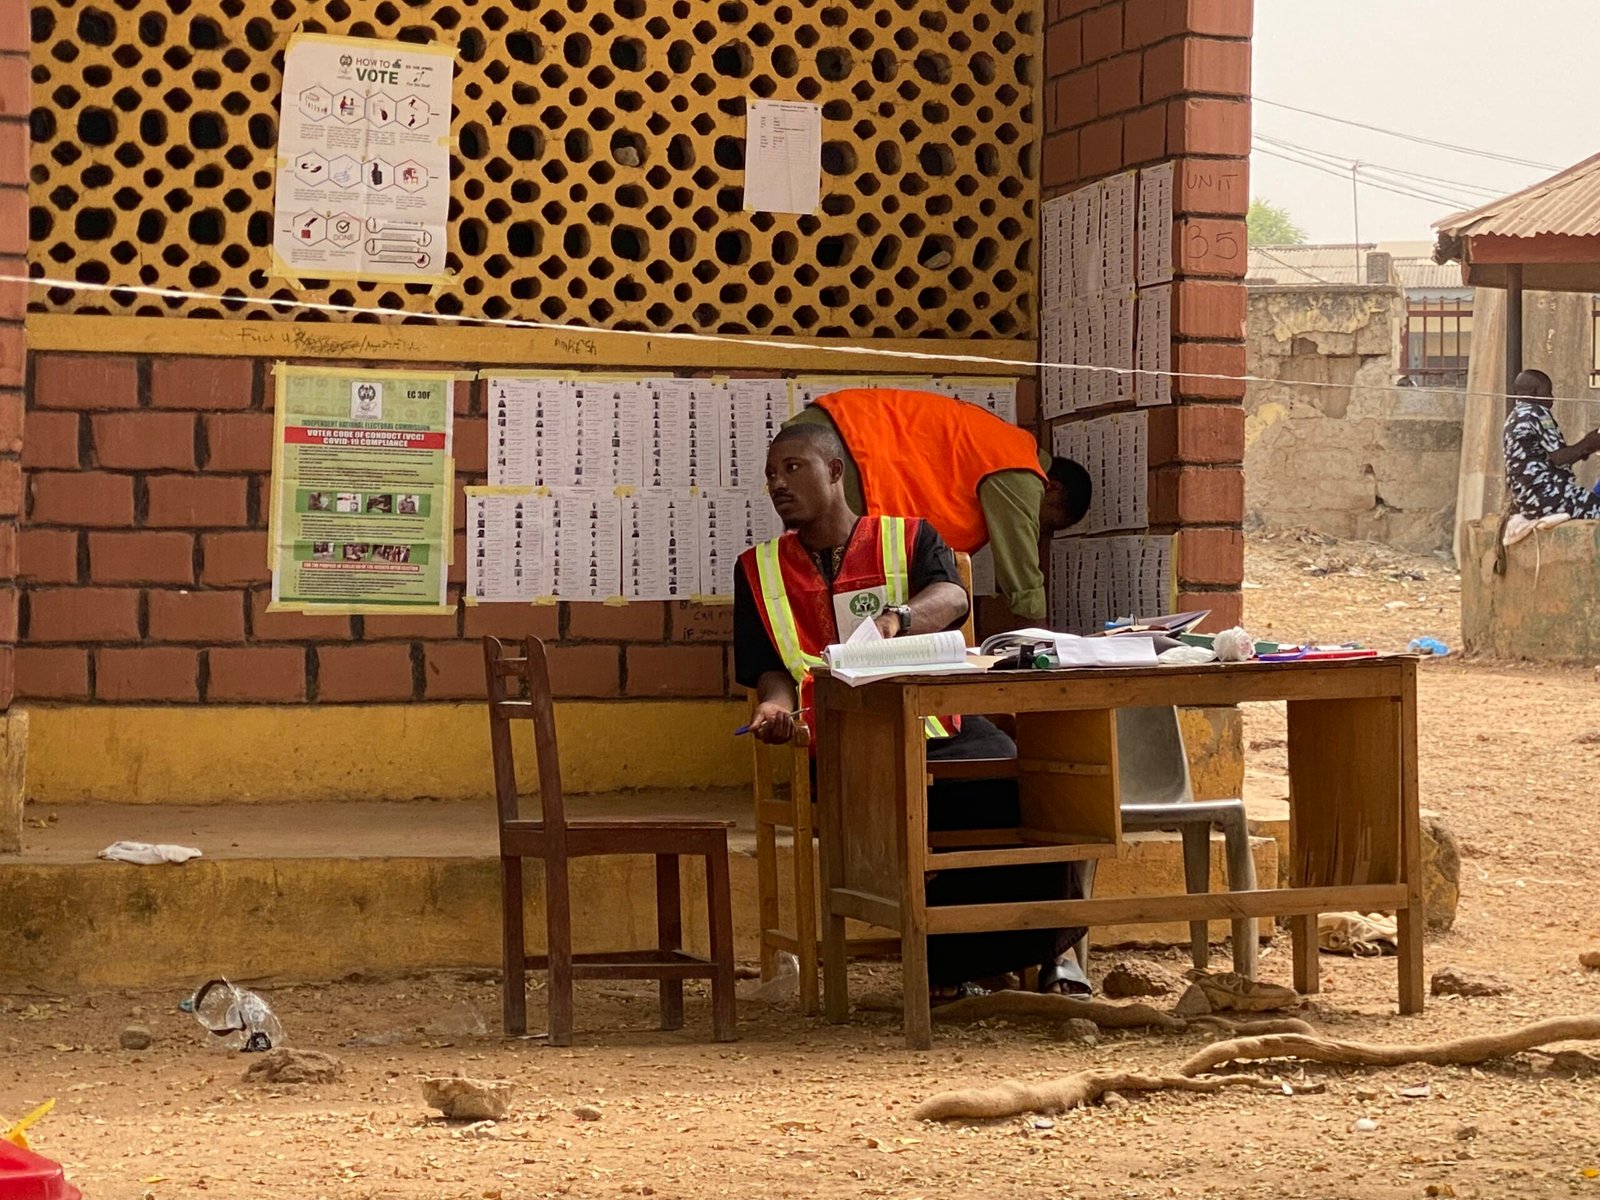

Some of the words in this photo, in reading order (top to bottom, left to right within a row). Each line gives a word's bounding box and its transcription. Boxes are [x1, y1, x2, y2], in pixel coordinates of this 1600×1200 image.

[355, 57, 377, 66] HOW
[379, 59, 390, 68] TO
[356, 67, 399, 85] VOTE
[1186, 170, 1239, 192] UNIT
[1187, 225, 1239, 260] 35
[407, 390, 416, 399] EC
[418, 391, 431, 400] 30F
[306, 429, 332, 438] VOTER
[333, 430, 354, 438] CODE
[354, 431, 364, 439] OF
[365, 431, 402, 440] CONDUCT
[403, 433, 425, 441] (VCC)
[323, 437, 359, 446] COVID-19
[360, 438, 408, 447] COMPLIANCE
